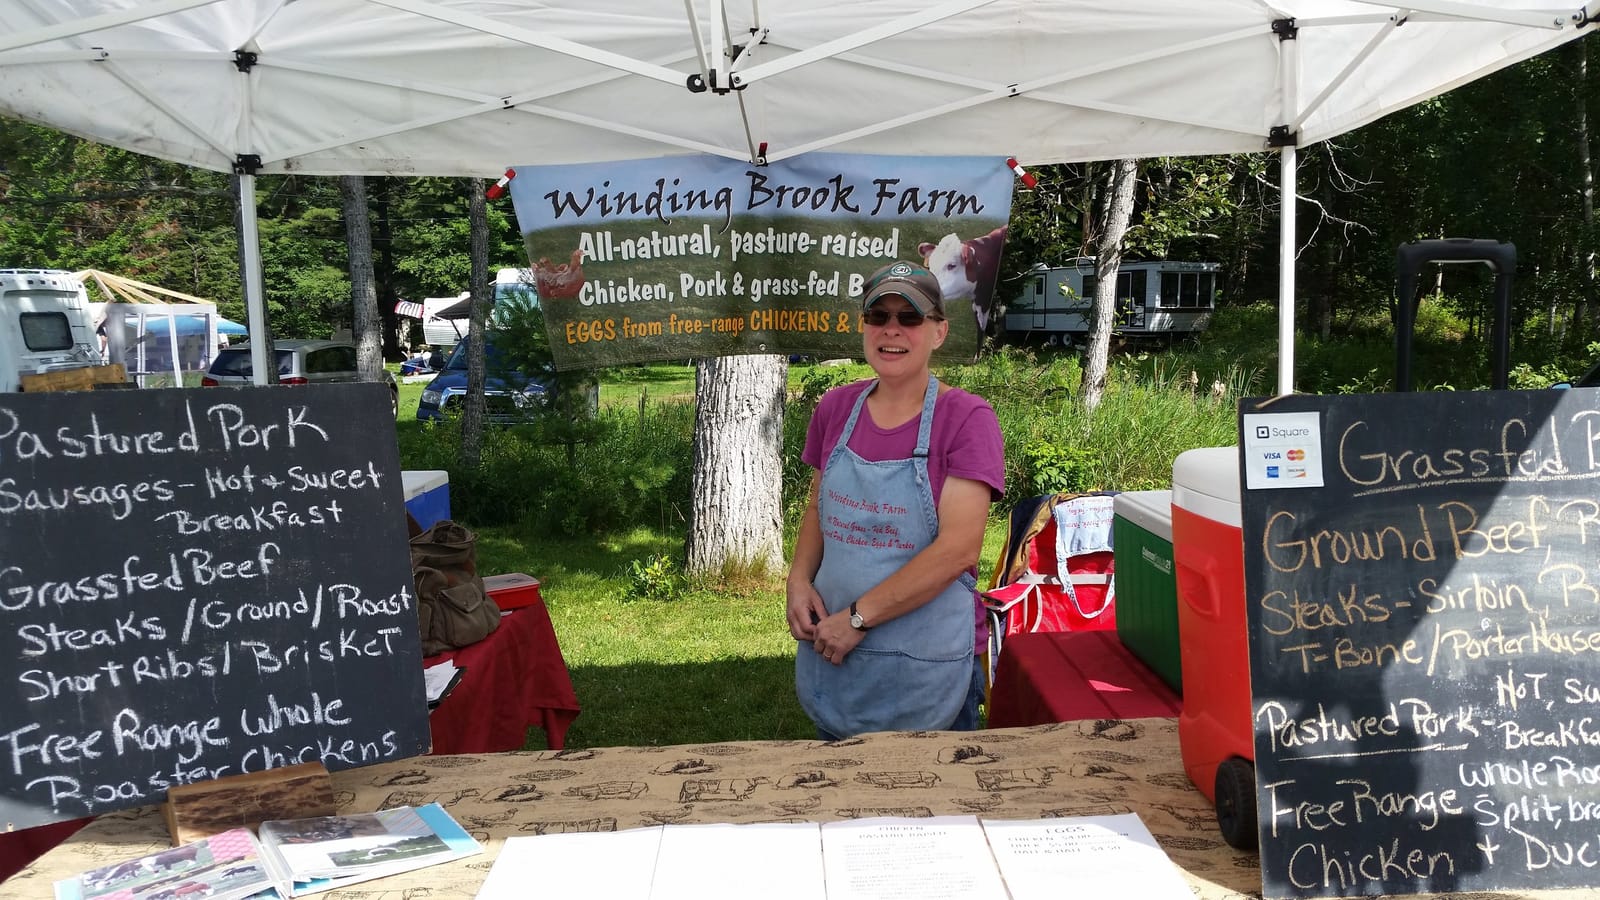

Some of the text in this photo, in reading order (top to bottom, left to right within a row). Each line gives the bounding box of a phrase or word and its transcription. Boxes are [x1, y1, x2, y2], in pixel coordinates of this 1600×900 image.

[543, 170, 985, 234] Winding Brook Farm
[579, 223, 721, 264] All-natural,
[578, 276, 675, 306] Chicken,
[680, 270, 727, 298] Pork
[731, 271, 745, 297] &
[750, 270, 840, 303] grass-fed
[565, 317, 616, 344] EGGS
[622, 316, 663, 339] from
[668, 313, 745, 338] free-range
[750, 307, 831, 333] CHICKENS
[836, 311, 851, 334] &
[1272, 427, 1310, 439] Square
[1338, 415, 1569, 486] Grassfed
[1263, 452, 1281, 460] VISA
[204, 463, 255, 499] Hot
[288, 460, 382, 493] Sweet
[1262, 503, 1437, 573] Ground
[0, 543, 280, 611] Grassfed Beef
[328, 583, 412, 619] Roast
[18, 660, 124, 702] Short
[0, 722, 103, 775] Free
[112, 707, 230, 764] Range
[1256, 700, 1400, 753] Pastured
[1263, 779, 1348, 838] Free
[1335, 779, 1464, 831] Range
[1510, 826, 1600, 871] Duc
